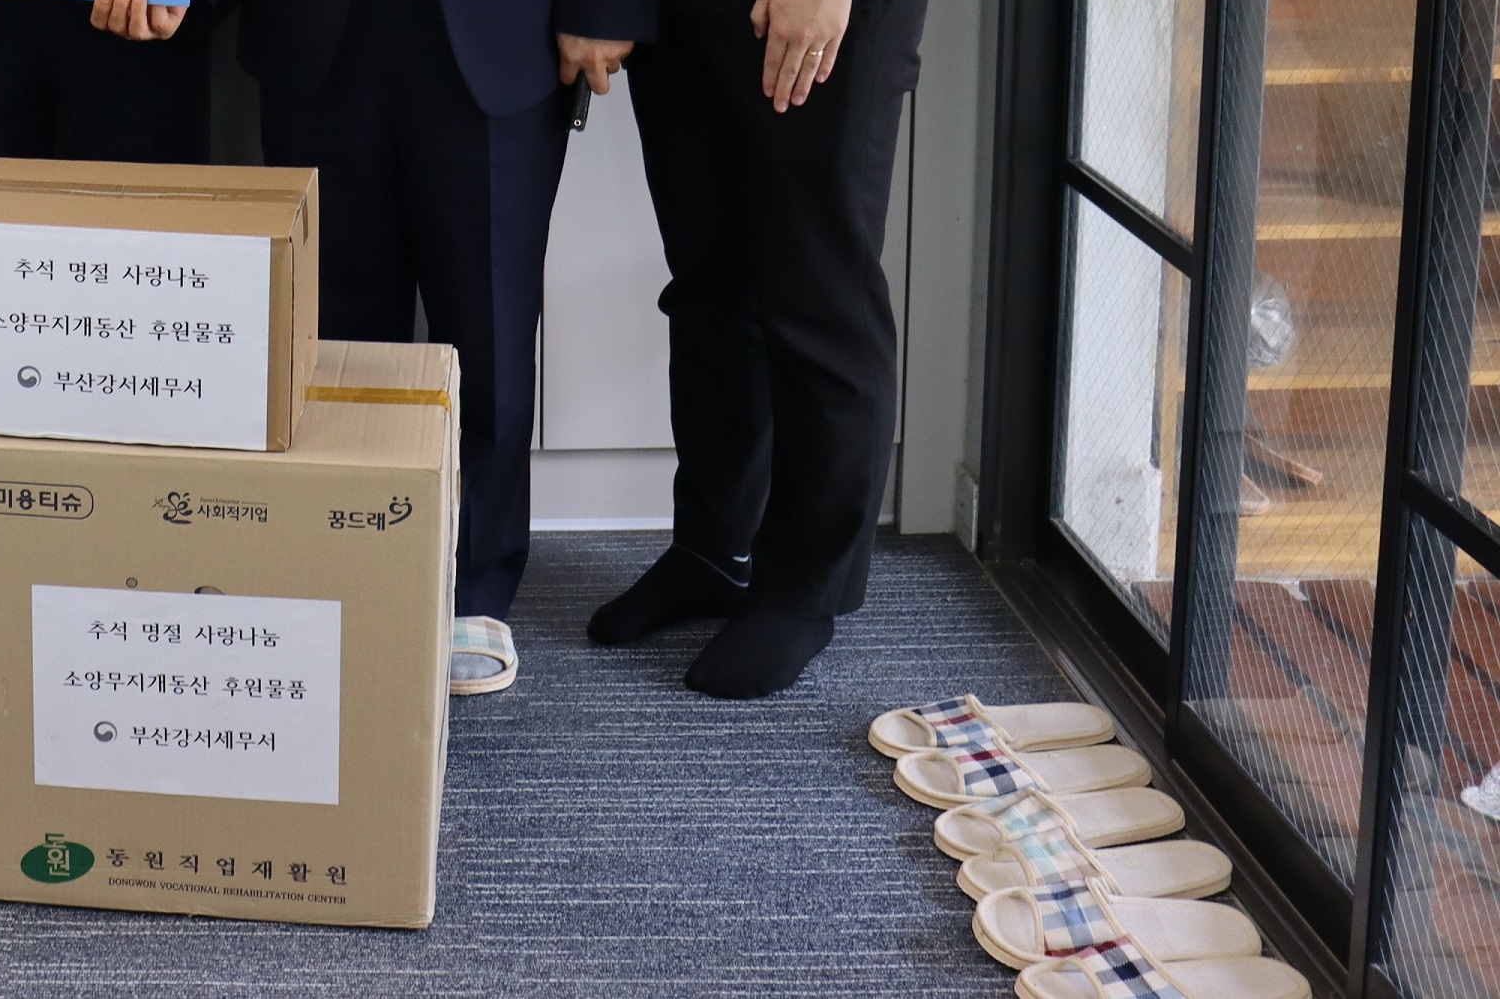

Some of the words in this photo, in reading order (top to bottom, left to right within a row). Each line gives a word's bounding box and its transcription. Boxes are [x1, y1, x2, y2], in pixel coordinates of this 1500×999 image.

[14, 258, 55, 281] 추석
[68, 262, 110, 284] 명절
[122, 264, 210, 290] 사랑나눔
[148, 320, 236, 344] 후원물품
[53, 370, 203, 400] 부산강서세무서
[197, 503, 269, 523] 사회적기업
[327, 509, 385, 532] 꿈드래
[88, 620, 128, 642] 추석
[141, 623, 182, 644] 명절
[195, 624, 280, 648] 사랑나눔
[63, 671, 210, 696] 소양무지개동산
[222, 677, 308, 701] 후원물품
[130, 725, 277, 752] 부산강서세무서
[108, 877, 157, 889] DONGWON
[160, 881, 220, 895] VOCATIONAL
[223, 887, 304, 902] REHABILITATION
[307, 893, 347, 905] CENTER
